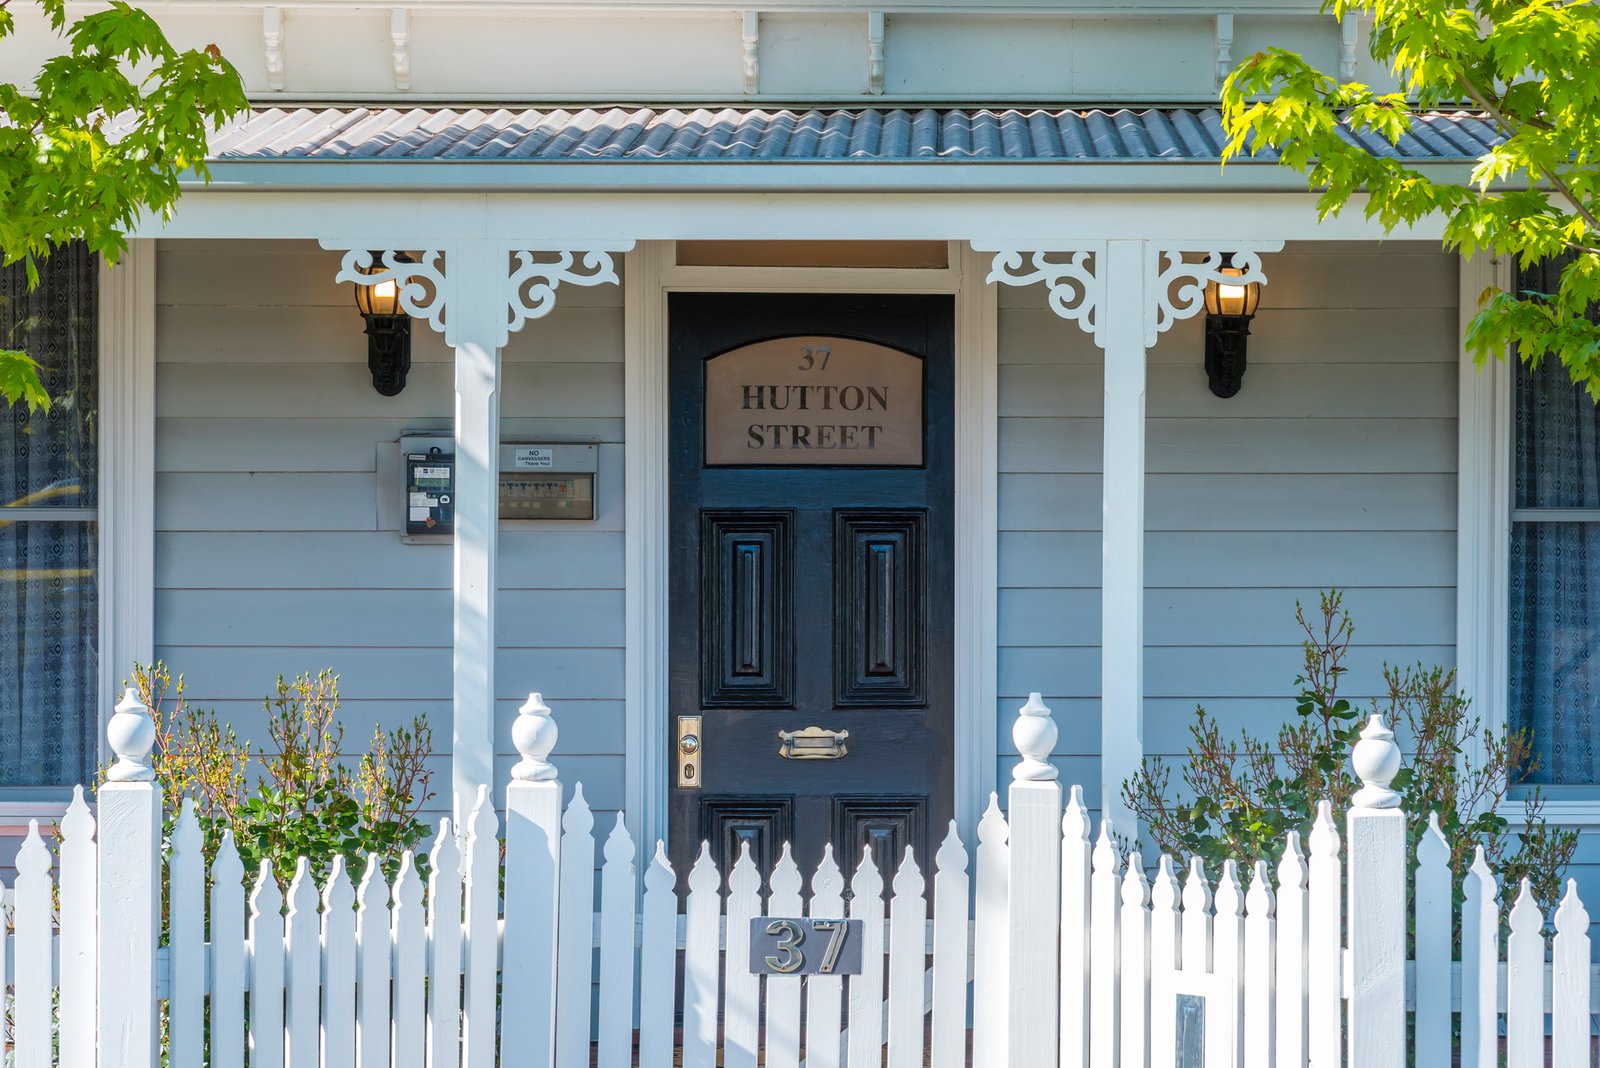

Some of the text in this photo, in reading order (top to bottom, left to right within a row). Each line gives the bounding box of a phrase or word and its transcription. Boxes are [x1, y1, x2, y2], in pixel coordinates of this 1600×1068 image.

[797, 344, 832, 371] 37
[741, 385, 888, 411] HUTTON
[747, 424, 883, 450] STREET
[765, 919, 848, 973] 37
